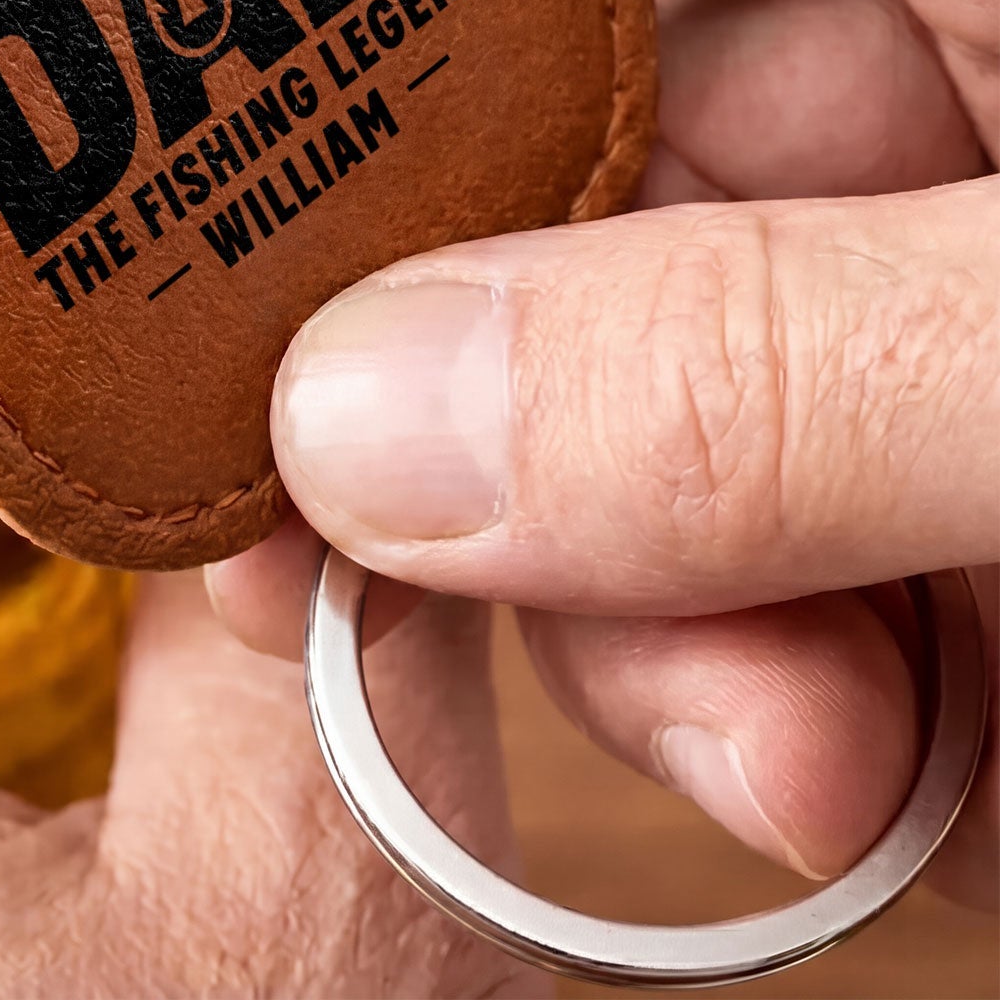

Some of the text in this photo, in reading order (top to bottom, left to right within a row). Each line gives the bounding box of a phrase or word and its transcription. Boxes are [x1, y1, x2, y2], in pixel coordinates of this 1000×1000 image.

[33, 208, 138, 314] THE
[128, 65, 321, 241] FISHING
[198, 86, 402, 271] WILLIAM
